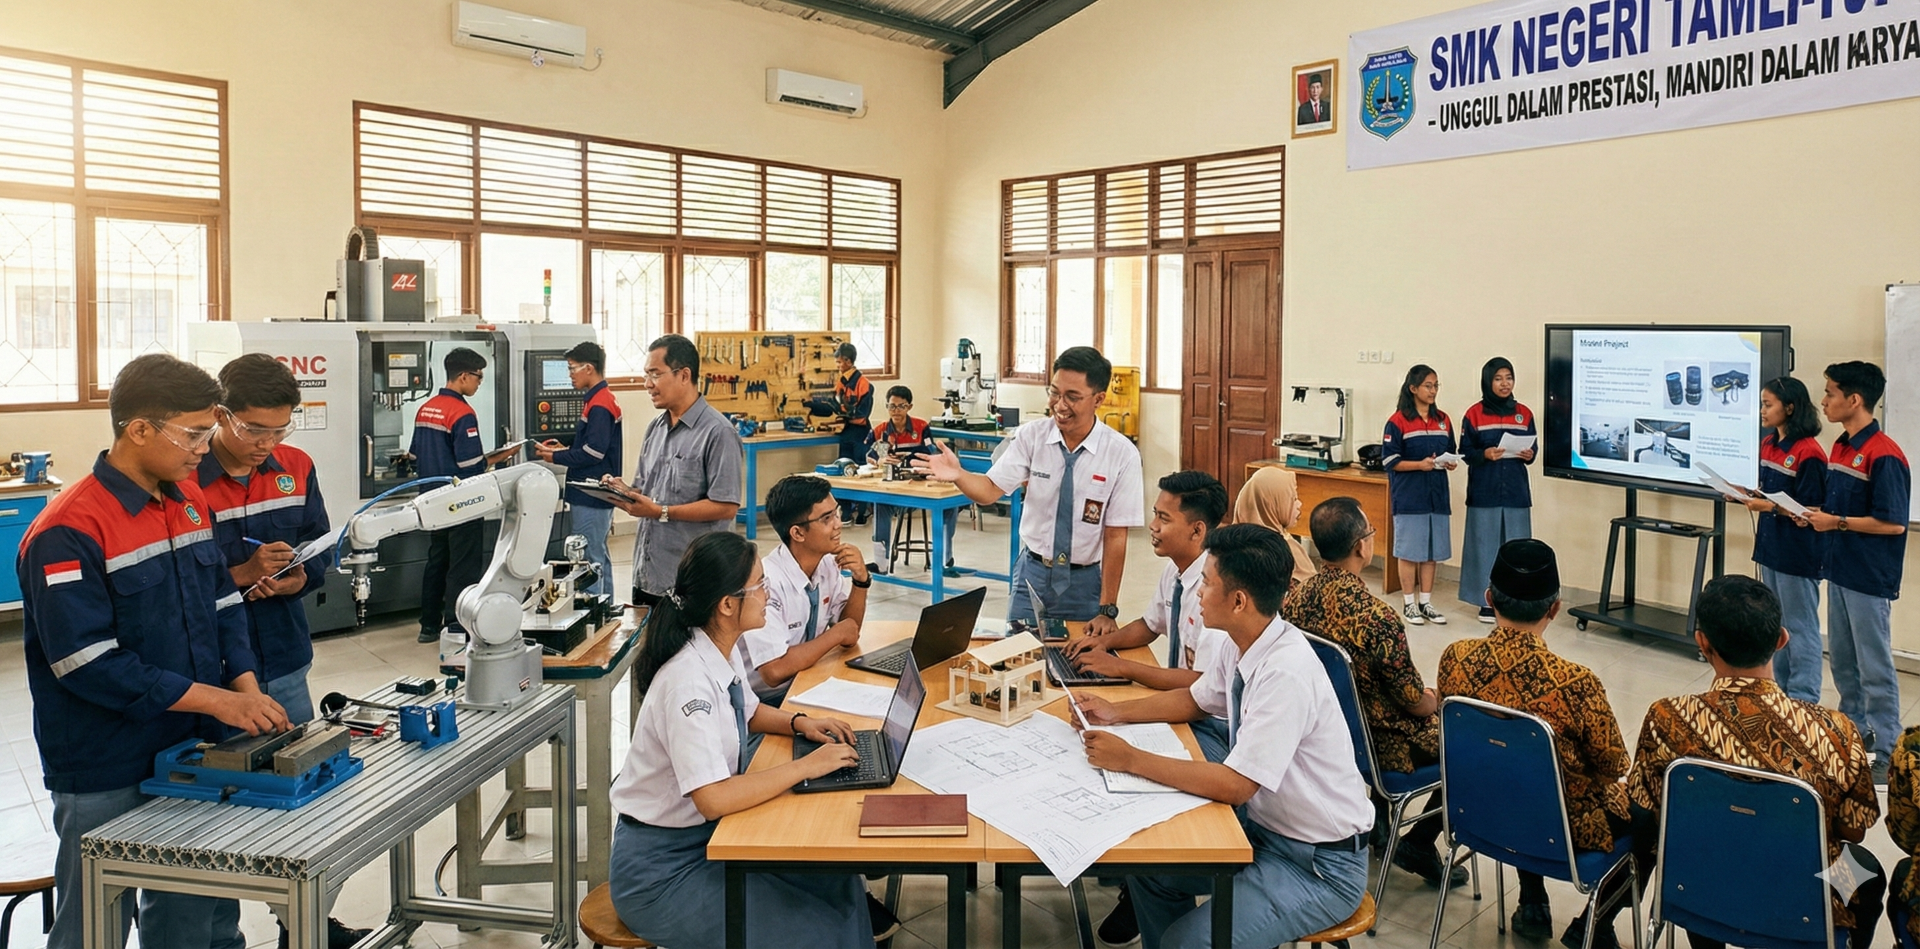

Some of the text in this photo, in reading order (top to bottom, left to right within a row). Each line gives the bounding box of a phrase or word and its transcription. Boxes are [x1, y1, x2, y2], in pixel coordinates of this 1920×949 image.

[1429, 24, 1502, 91] SMK
[1512, 0, 1650, 77] NEGERI
[1440, 95, 1503, 132] UNGGUL
[1507, 85, 1563, 123] DALAM
[1568, 69, 1660, 114] PRESTASI,
[1666, 51, 1754, 98] MANDIRI
[1760, 36, 1840, 84] DALAM
